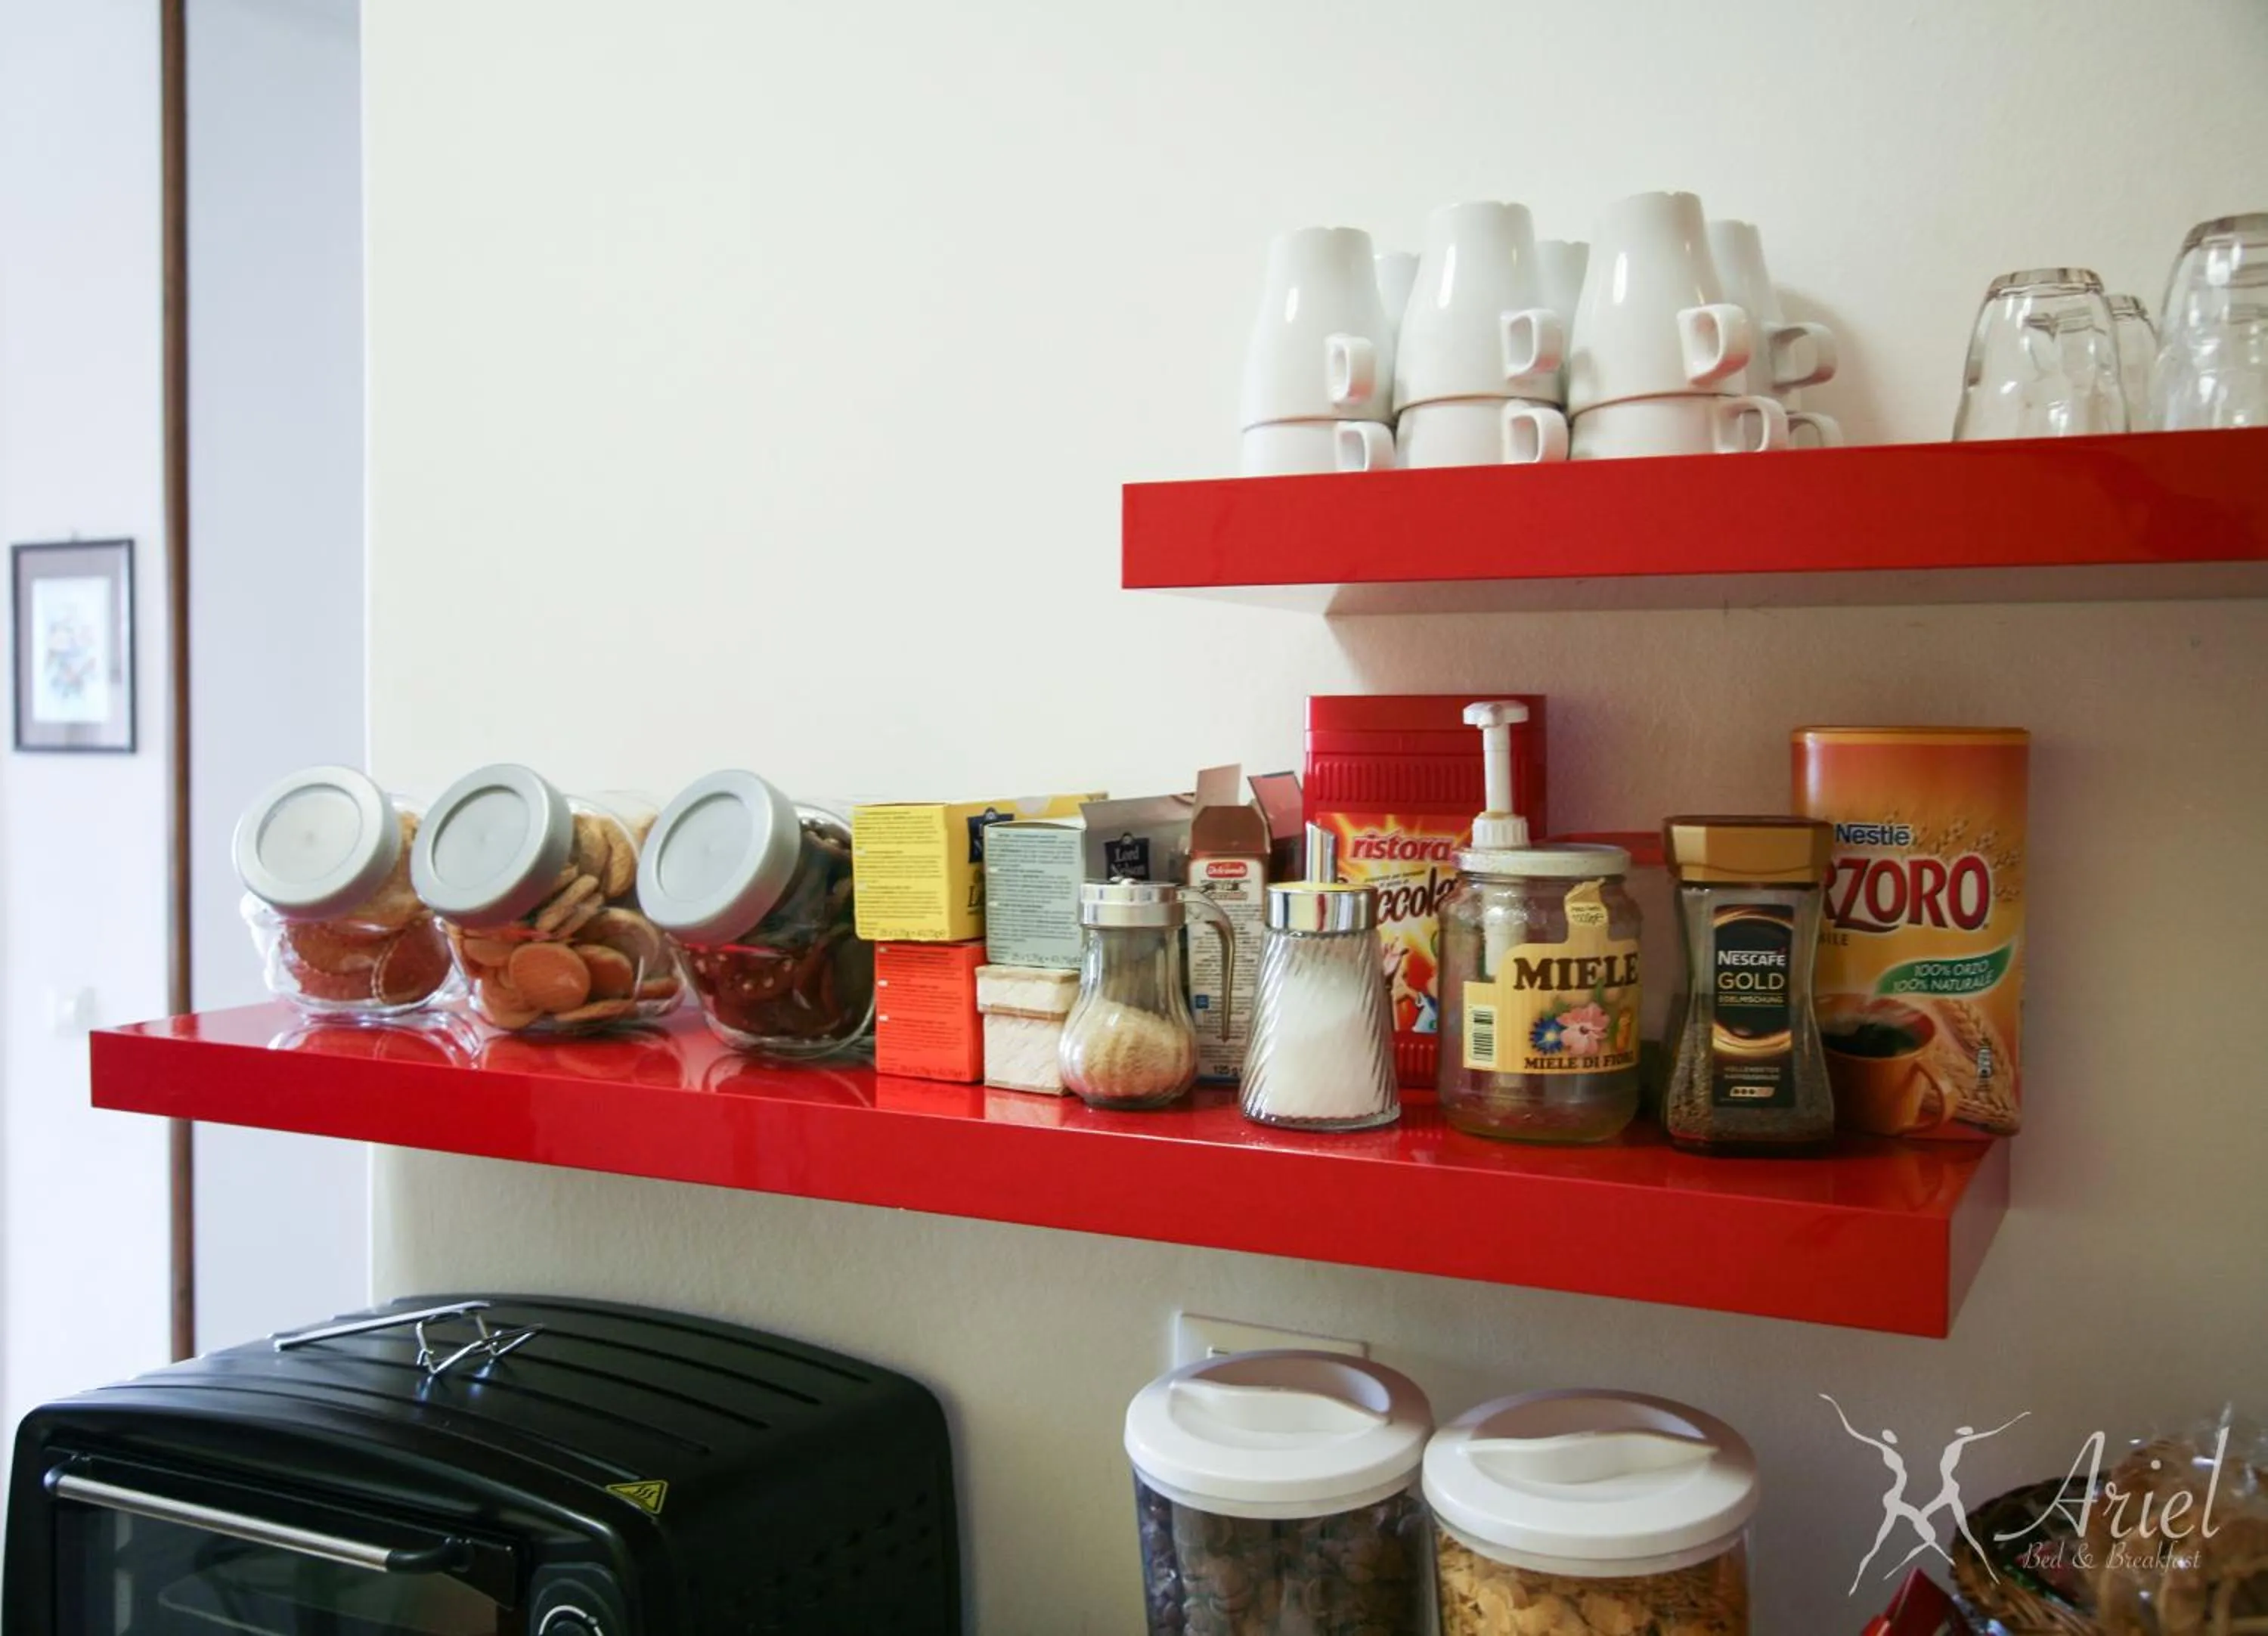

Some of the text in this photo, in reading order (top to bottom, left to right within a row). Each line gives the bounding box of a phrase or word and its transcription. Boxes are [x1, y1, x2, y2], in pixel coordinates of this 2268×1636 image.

[1114, 844, 1140, 863] Lord
[1351, 832, 1453, 861] ristora
[1513, 953, 1639, 991] MIELE
[1718, 971, 1785, 990] GOLD
[1932, 971, 1994, 990] NATURALE
[1524, 1056, 1577, 1070] MIELE
[1582, 1056, 1600, 1068] DI
